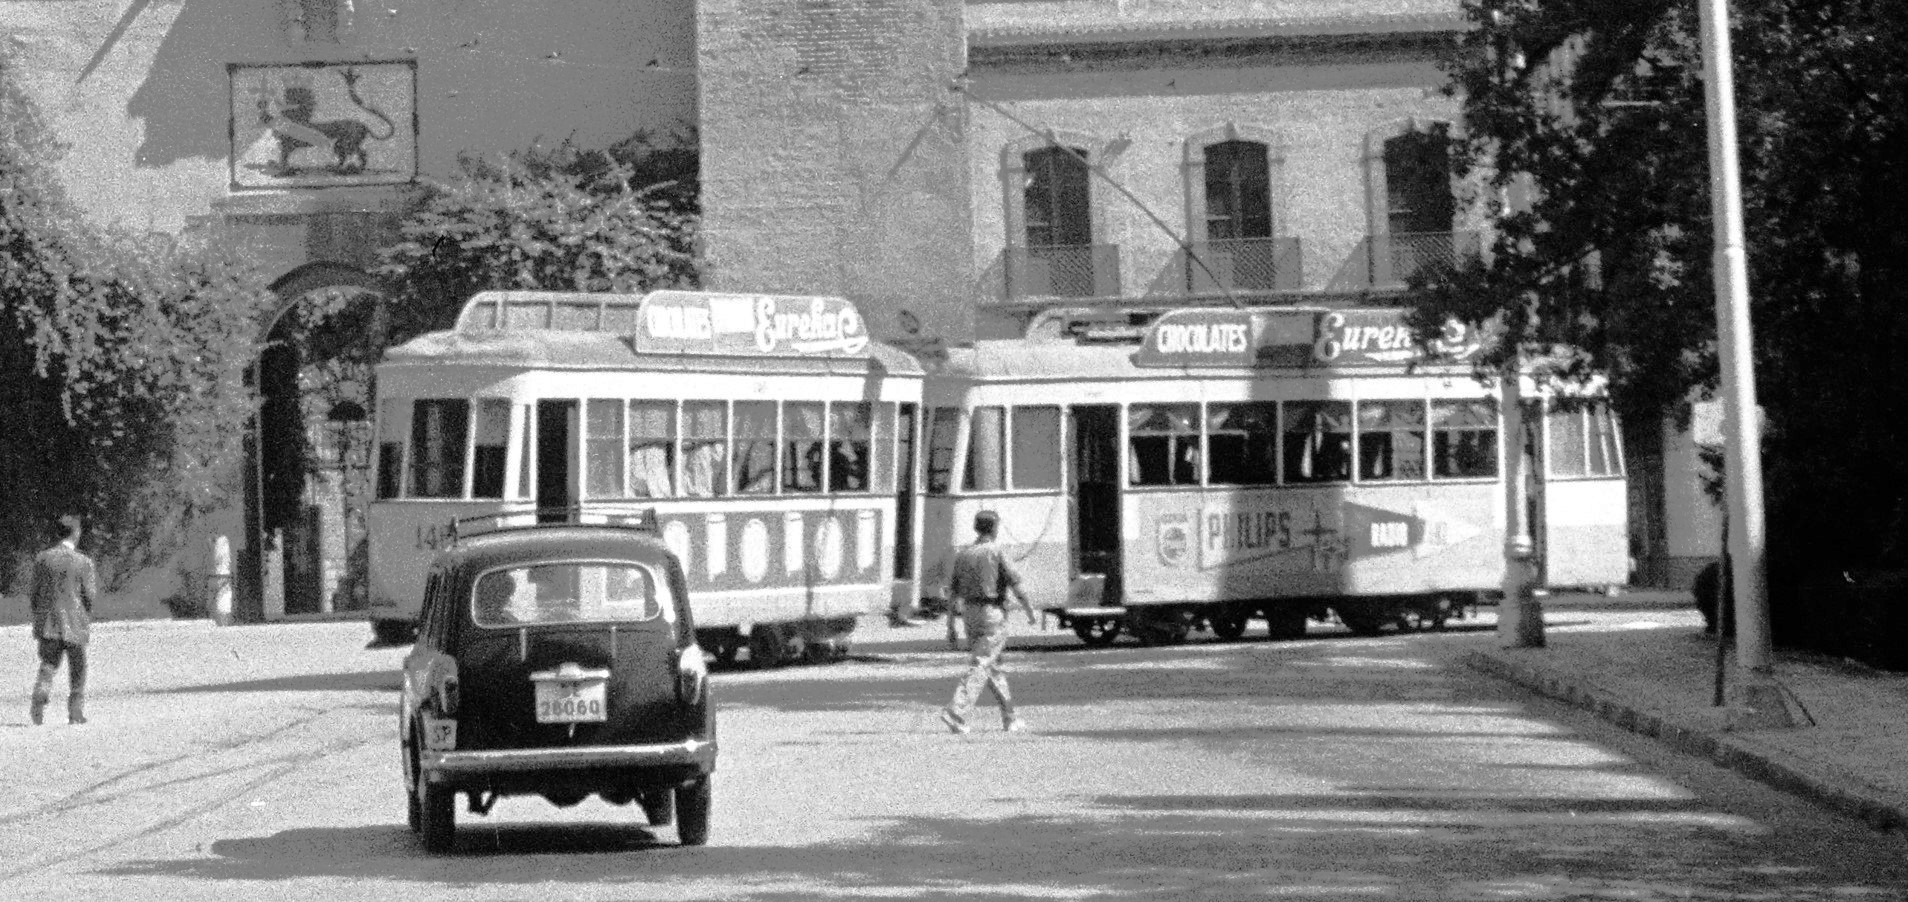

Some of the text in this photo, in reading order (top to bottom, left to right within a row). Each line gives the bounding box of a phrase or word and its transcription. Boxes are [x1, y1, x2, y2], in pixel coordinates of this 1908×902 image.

[755, 298, 868, 353] Eureka
[1157, 323, 1247, 353] CHOCOLATES
[433, 725, 452, 743] SP
